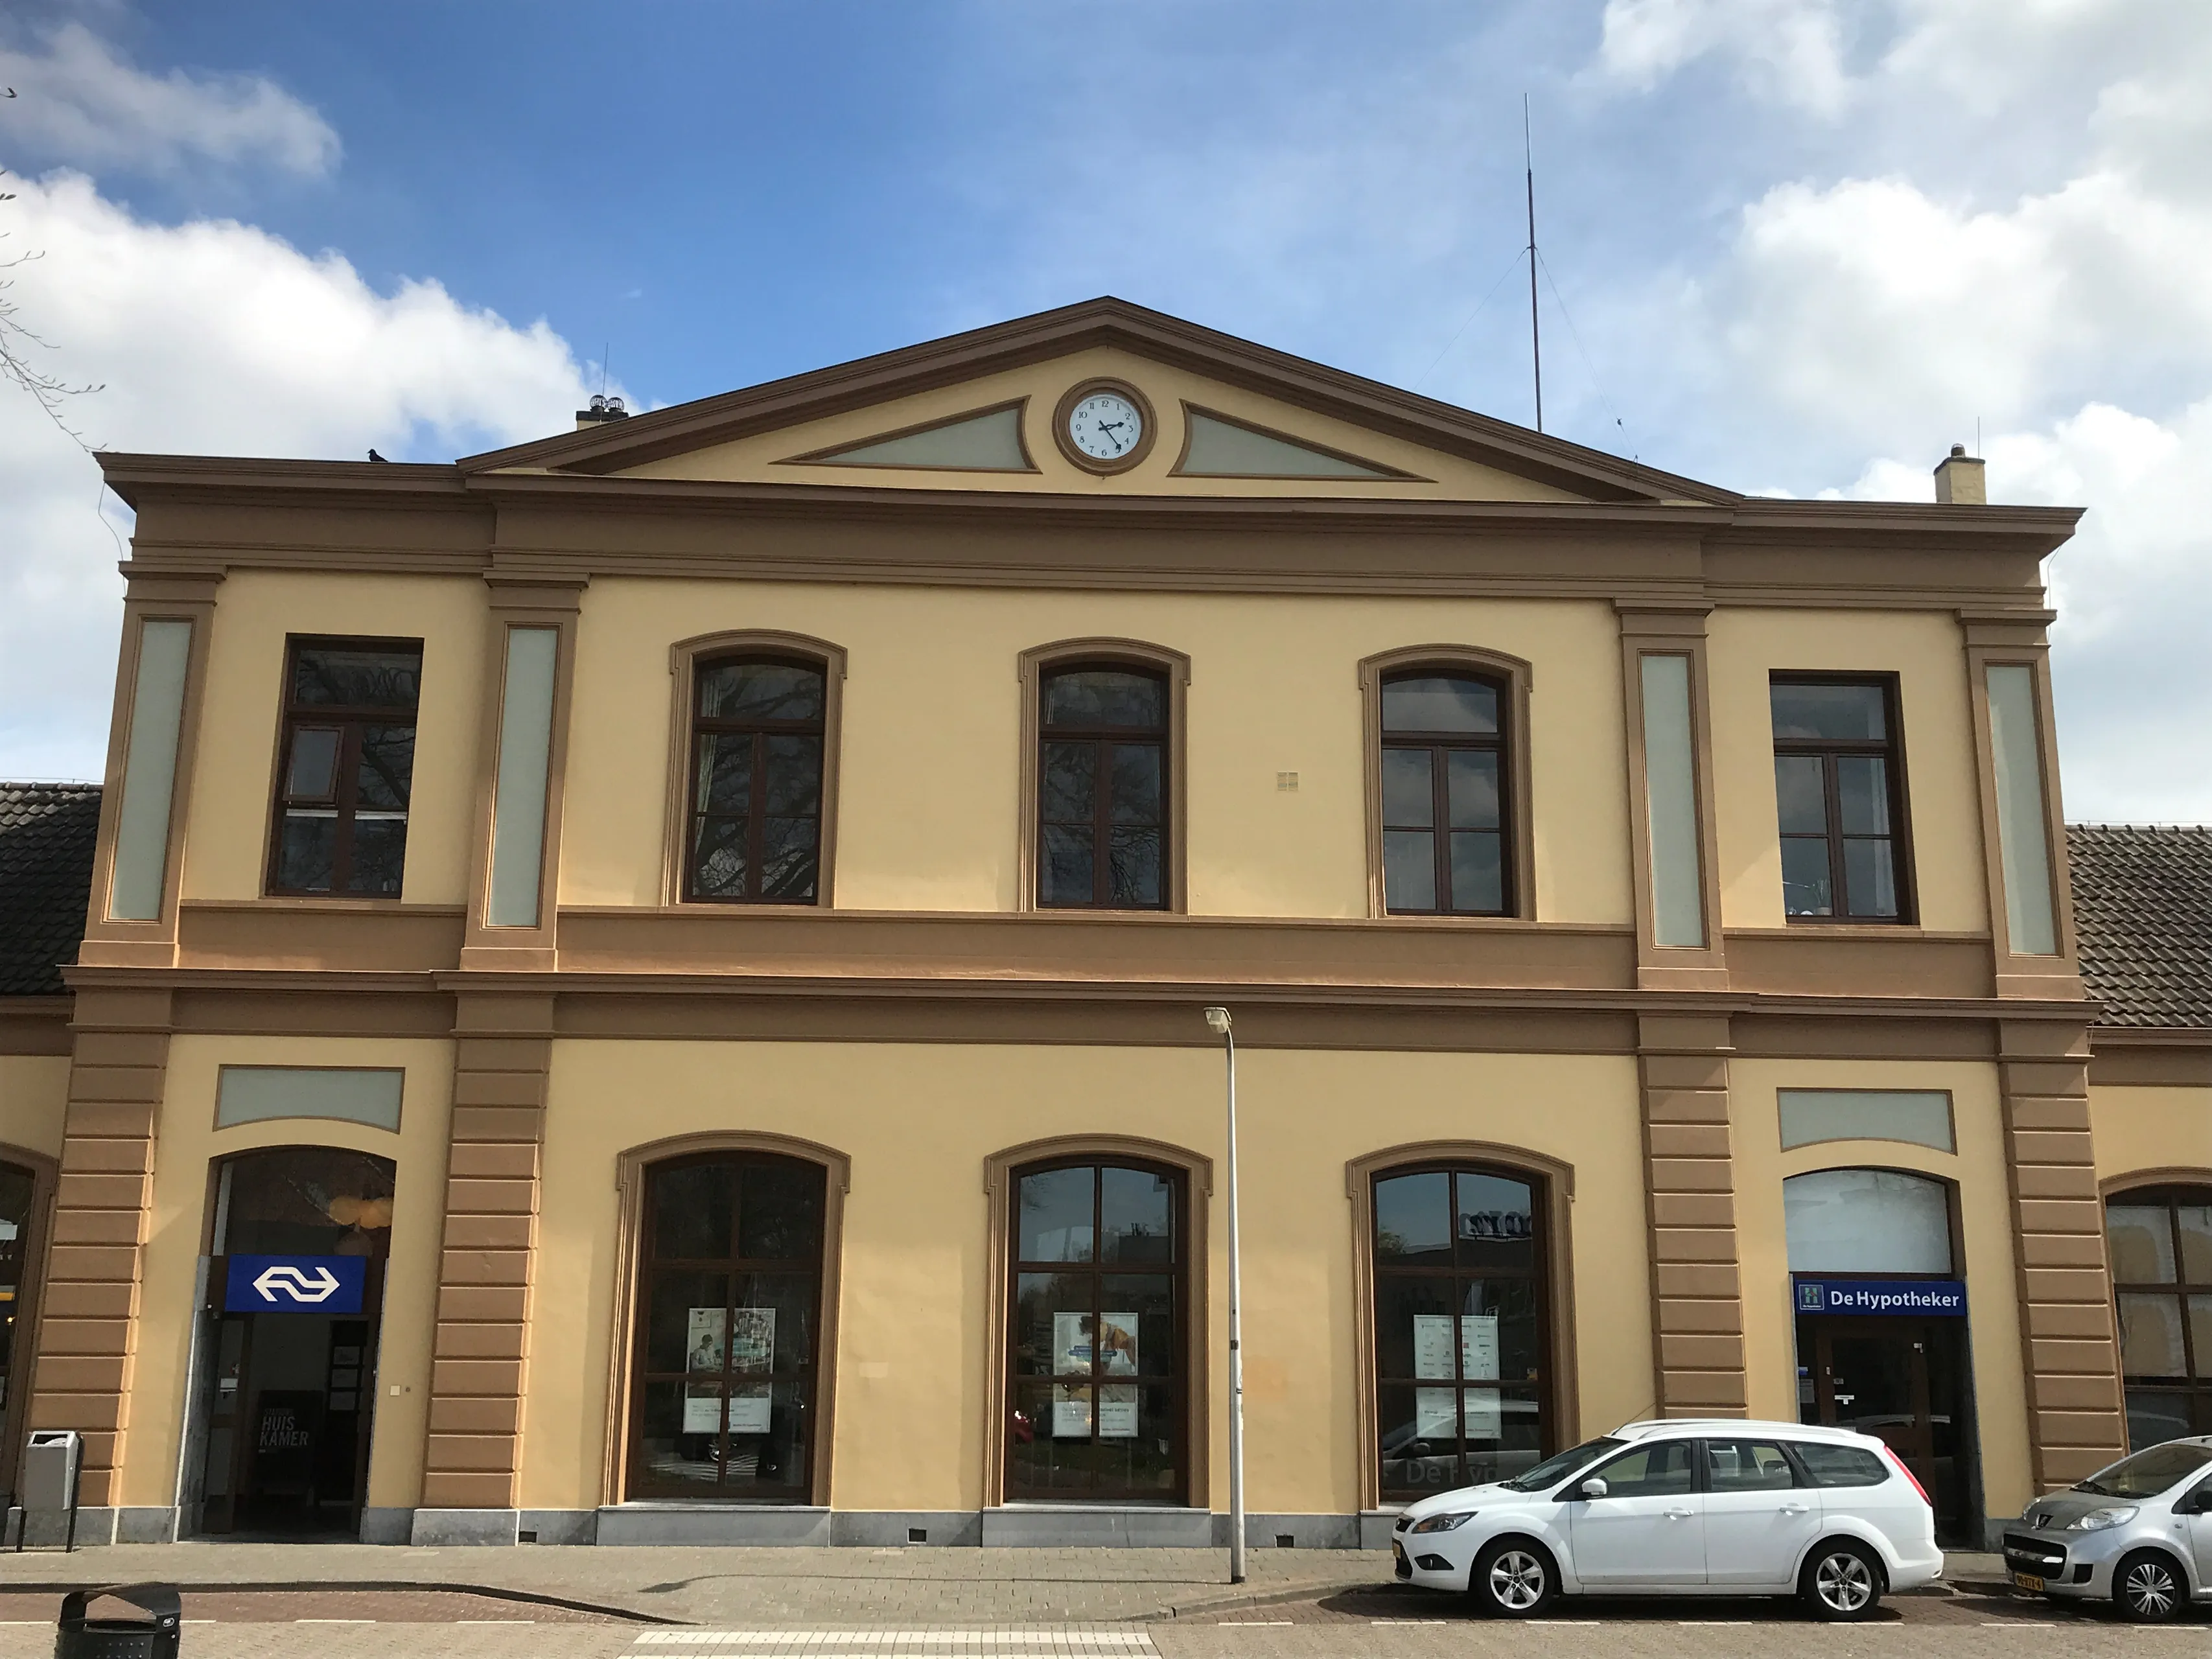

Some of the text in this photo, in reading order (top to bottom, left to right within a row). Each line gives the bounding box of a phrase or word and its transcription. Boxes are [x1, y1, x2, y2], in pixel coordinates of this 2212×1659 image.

[1831, 1291, 1959, 1310] De Hypotheker
[261, 1416, 296, 1431] HUIS
[259, 1430, 309, 1446] KAMER
[1406, 1459, 1441, 1483] De
